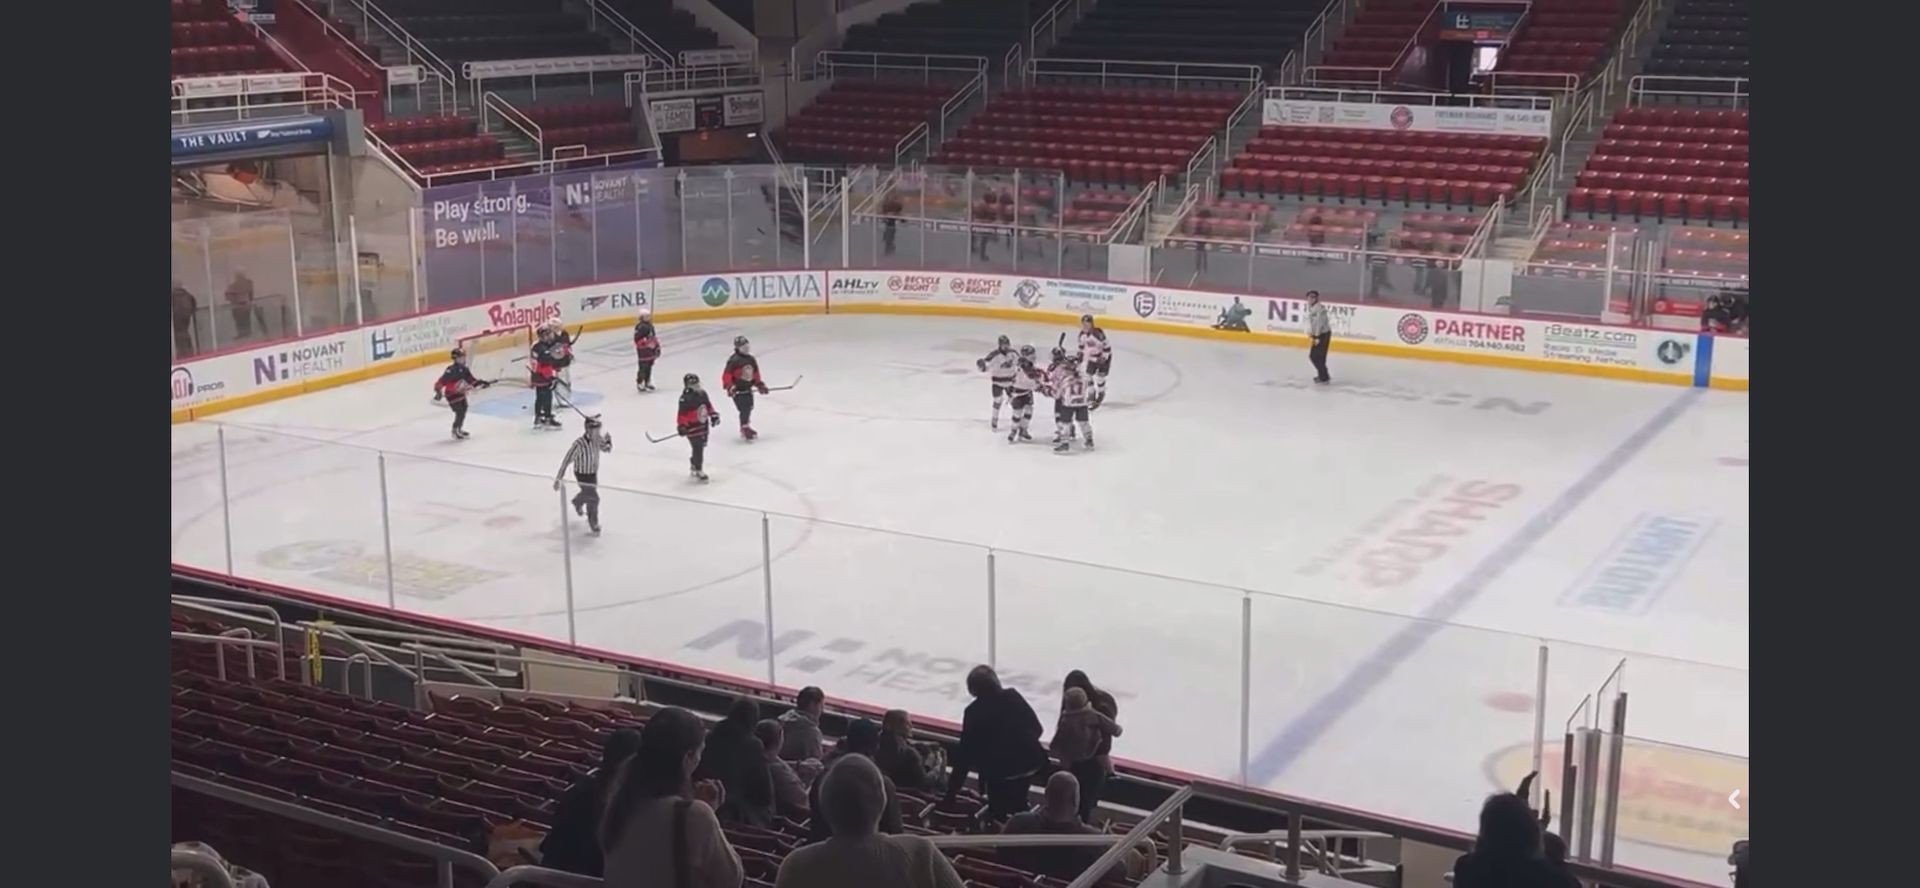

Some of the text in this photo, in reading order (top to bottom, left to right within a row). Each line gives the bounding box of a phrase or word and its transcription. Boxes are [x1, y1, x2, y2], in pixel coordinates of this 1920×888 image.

[181, 131, 247, 148] THE VAULT
[434, 199, 470, 222] Play
[435, 228, 458, 248] Be
[735, 275, 821, 299] MEMA
[902, 284, 930, 292] RIGHT
[904, 275, 941, 285] RECYCLE
[966, 278, 1002, 288] RECYCLE
[965, 286, 991, 295] RIGHT
[488, 299, 561, 328] Bojangles
[1435, 319, 1525, 341] PARTNER
[292, 341, 347, 362] NOVANT
[292, 357, 343, 377] HEALTH
[196, 381, 225, 394] PROS
[1357, 479, 1522, 589] SHARP
